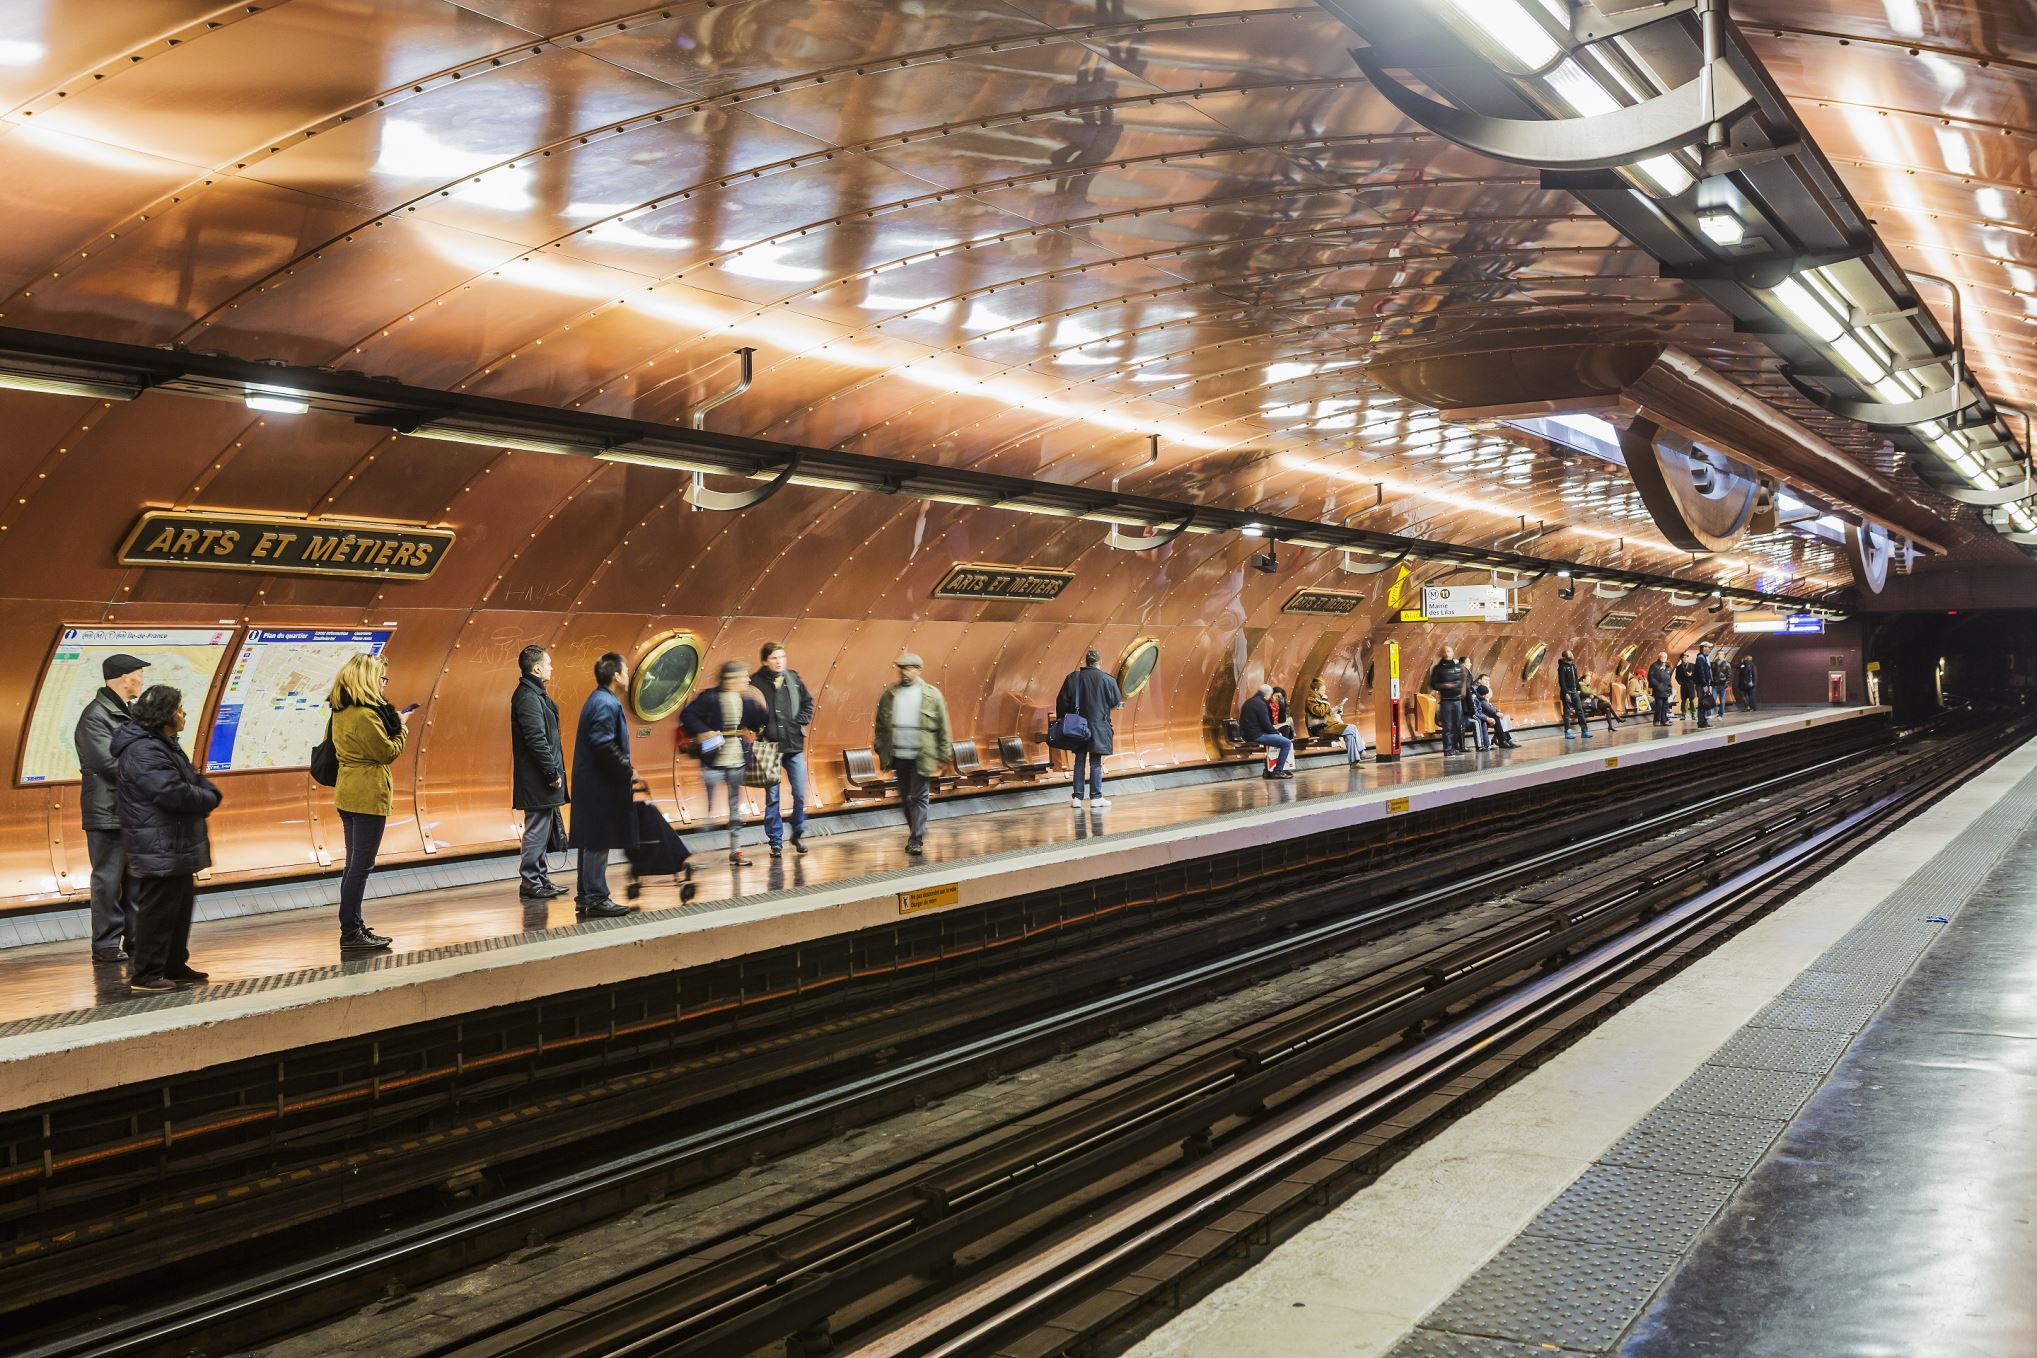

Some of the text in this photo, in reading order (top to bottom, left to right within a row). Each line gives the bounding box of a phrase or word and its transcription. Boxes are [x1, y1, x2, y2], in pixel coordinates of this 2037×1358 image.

[145, 527, 433, 567] ARTS ET MÉTIERS
[947, 574, 989, 590] ARTS
[987, 577, 1010, 592] ET
[1441, 590, 1449, 598] 11
